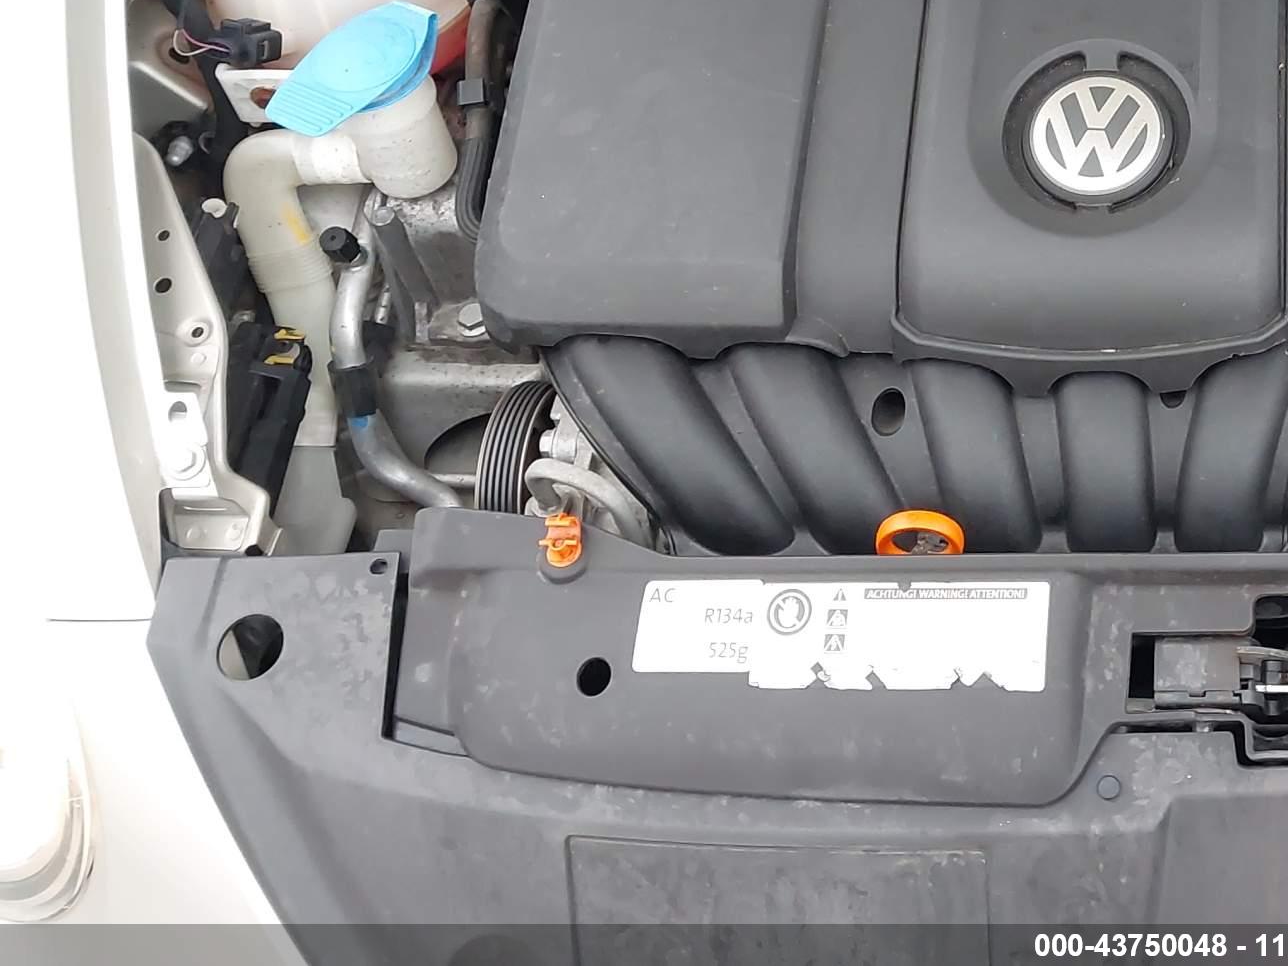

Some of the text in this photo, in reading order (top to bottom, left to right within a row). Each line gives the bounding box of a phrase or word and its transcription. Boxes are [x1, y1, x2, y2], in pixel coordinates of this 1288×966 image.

[649, 587, 677, 603] AC
[866, 588, 1025, 600] ACHTUNG! WARNING! ATTENTION!
[704, 607, 754, 624] R134a
[708, 642, 749, 664] 525g
